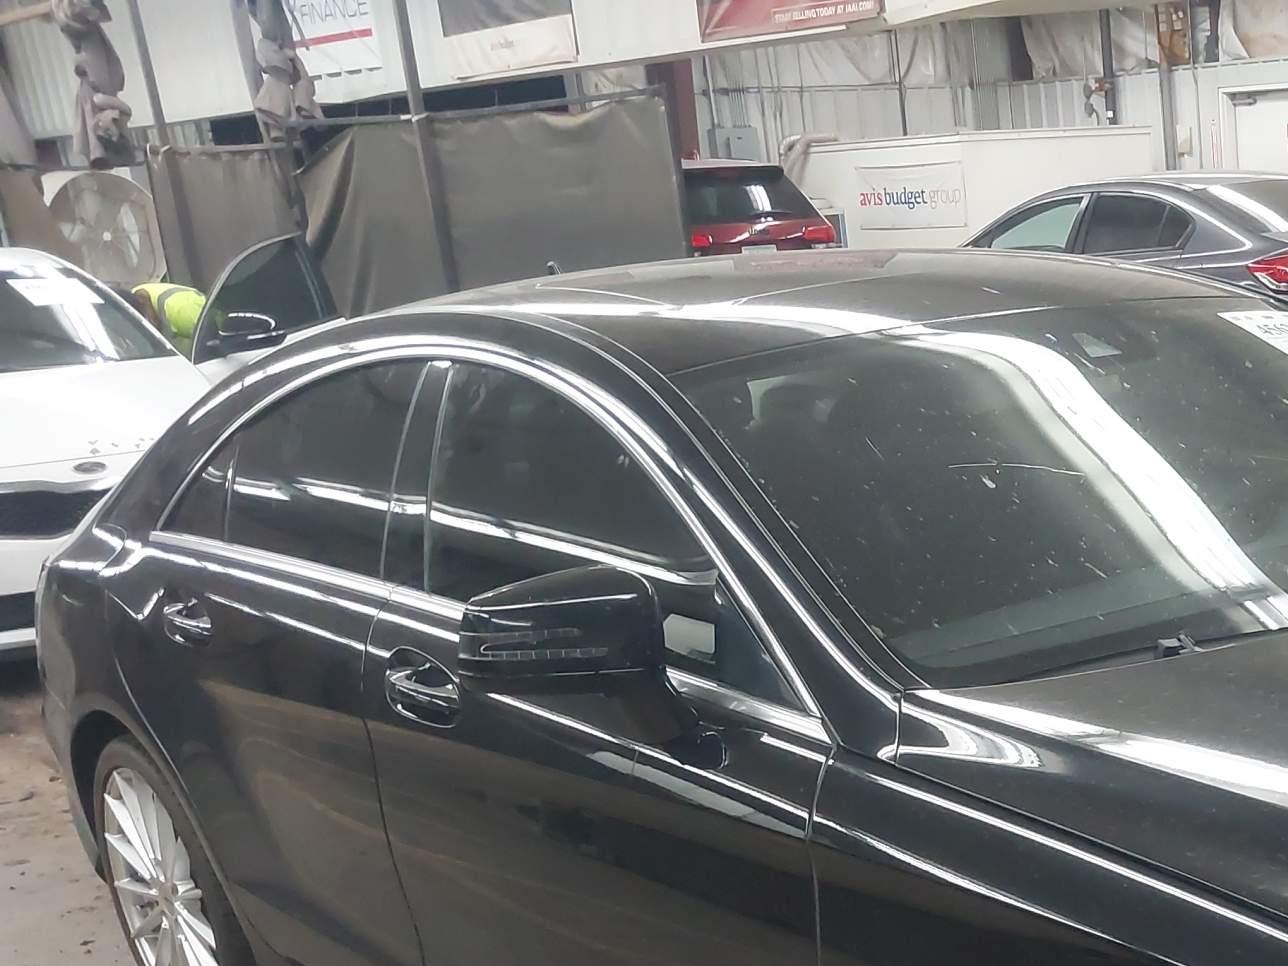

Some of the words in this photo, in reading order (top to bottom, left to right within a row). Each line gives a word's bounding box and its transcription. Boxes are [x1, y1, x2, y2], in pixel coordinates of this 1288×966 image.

[300, 0, 368, 24] FINANCE
[816, 6, 836, 16] TODAY
[860, 187, 883, 206] avis
[883, 186, 928, 210] budget
[928, 188, 962, 210] group
